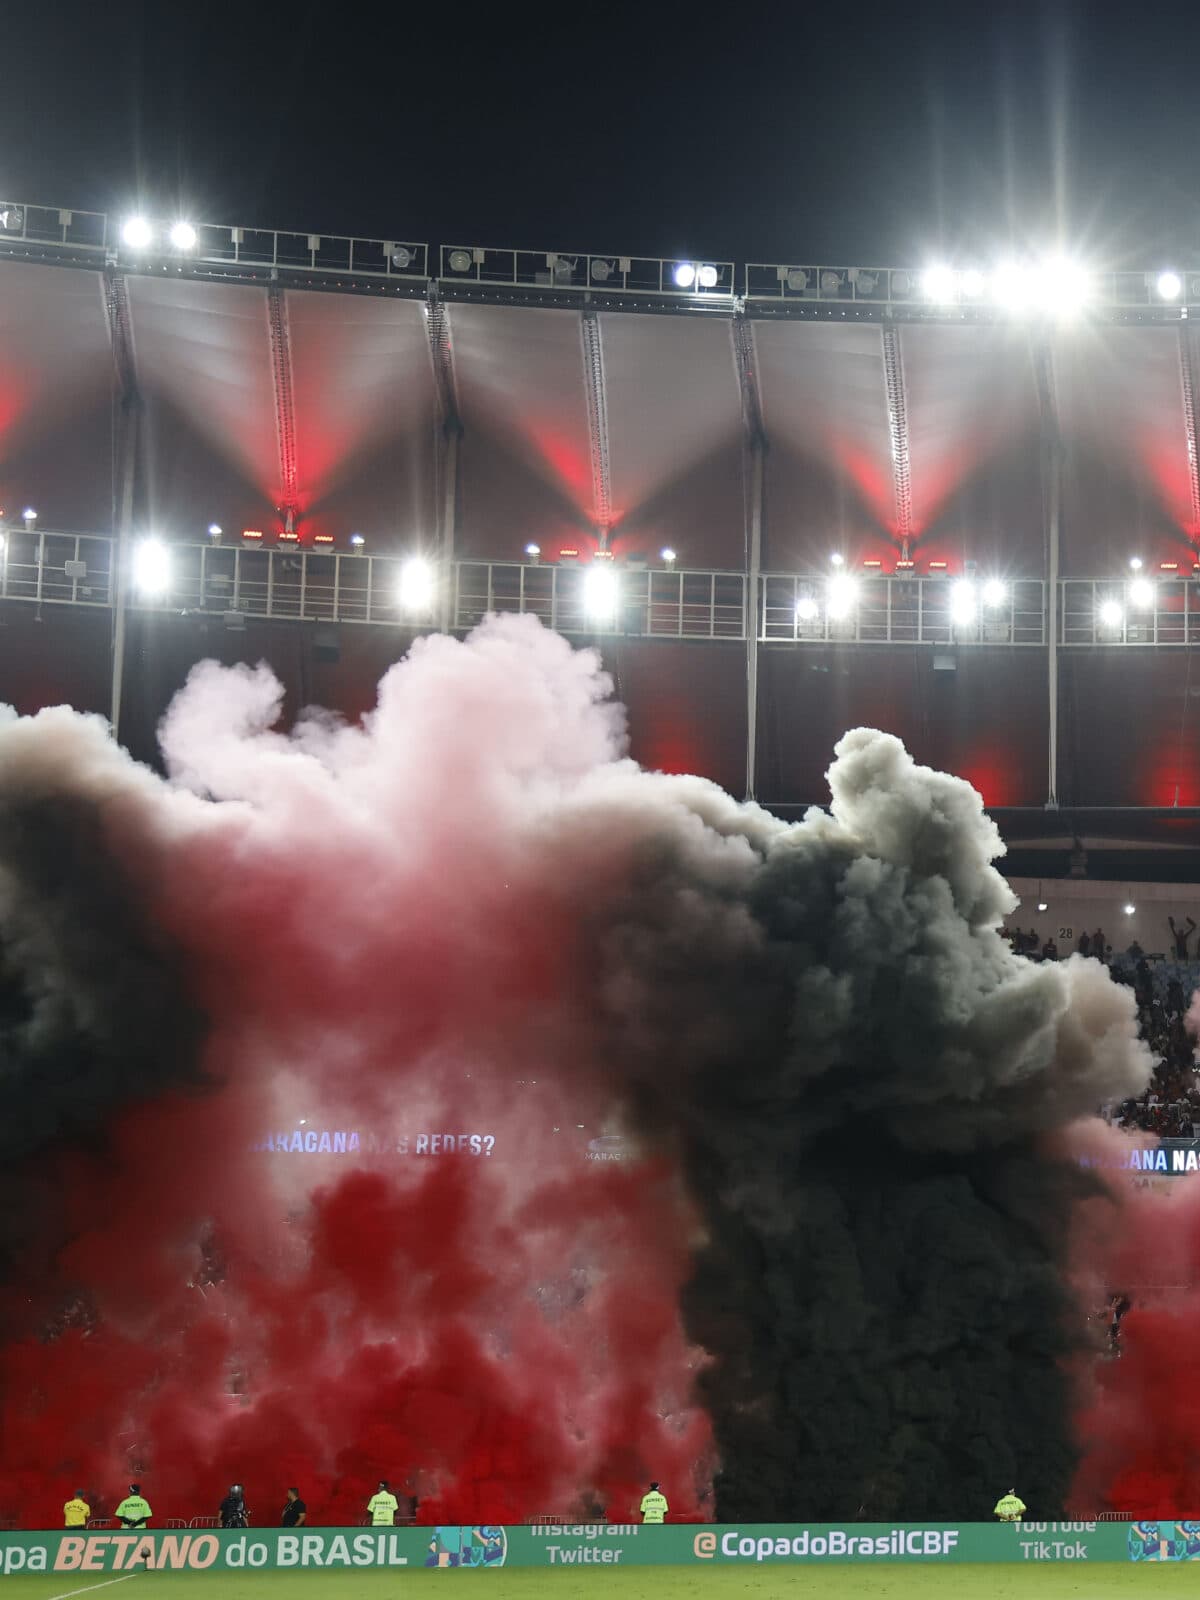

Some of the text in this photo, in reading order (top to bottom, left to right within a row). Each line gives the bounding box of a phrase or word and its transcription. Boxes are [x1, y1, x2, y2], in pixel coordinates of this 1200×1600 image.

[1059, 927, 1073, 939] 28
[0, 1534, 408, 1574] pa BETANO do BRASIL
[546, 1545, 623, 1564] Twitter
[694, 1529, 959, 1561] @CopadoBrasilCBF
[1019, 1540, 1089, 1560] TikTok
